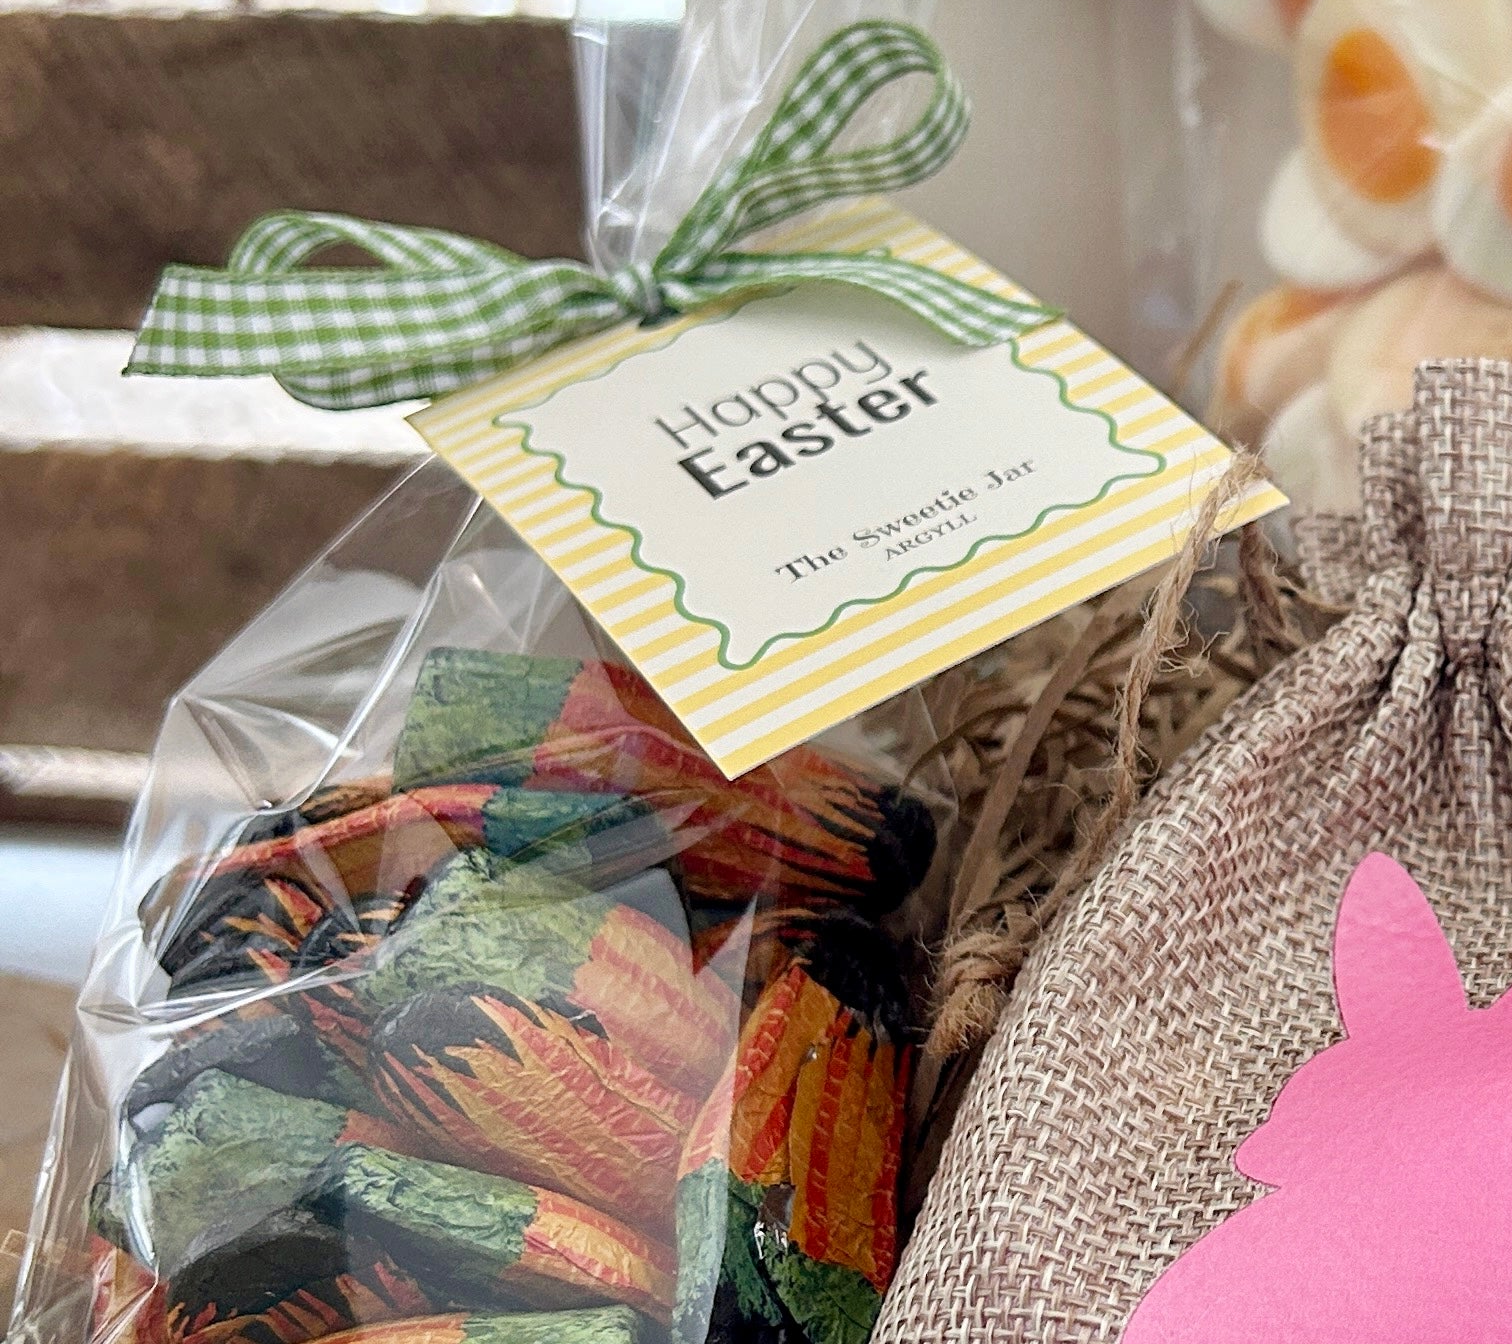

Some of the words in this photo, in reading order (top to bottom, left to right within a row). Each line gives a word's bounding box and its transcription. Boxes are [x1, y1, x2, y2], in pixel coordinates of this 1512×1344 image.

[654, 339, 893, 450] Happy
[676, 368, 938, 501] Easter
[774, 545, 849, 584] The
[851, 488, 979, 549] Sweetie
[986, 458, 1038, 491] Jar
[884, 511, 979, 562] ARGYLL
